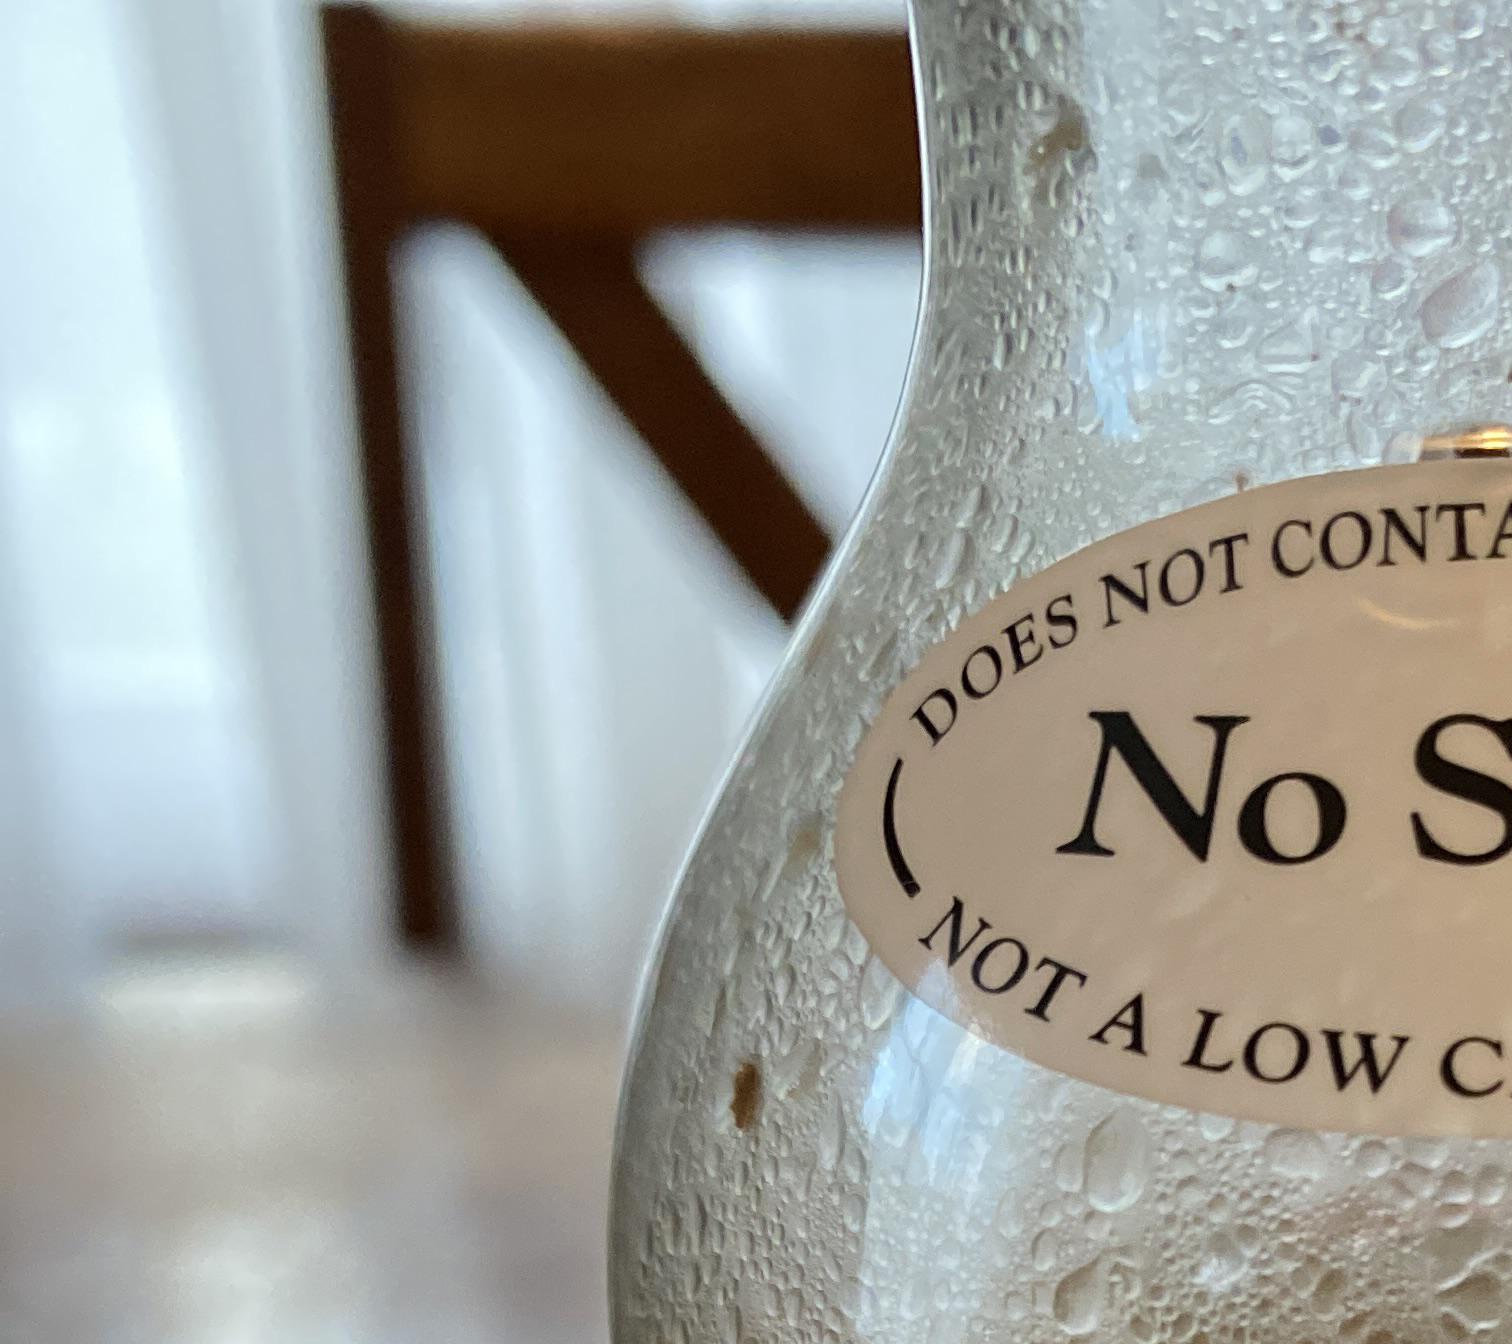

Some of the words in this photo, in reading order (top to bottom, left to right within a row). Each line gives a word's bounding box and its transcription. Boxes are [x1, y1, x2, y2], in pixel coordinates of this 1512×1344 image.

[907, 593, 1079, 749] DOES
[1096, 532, 1249, 631] NOT
[1054, 709, 1349, 867] No
[916, 894, 1089, 1024] NOT
[1087, 990, 1149, 1058] A
[1180, 1008, 1412, 1096] LOW
